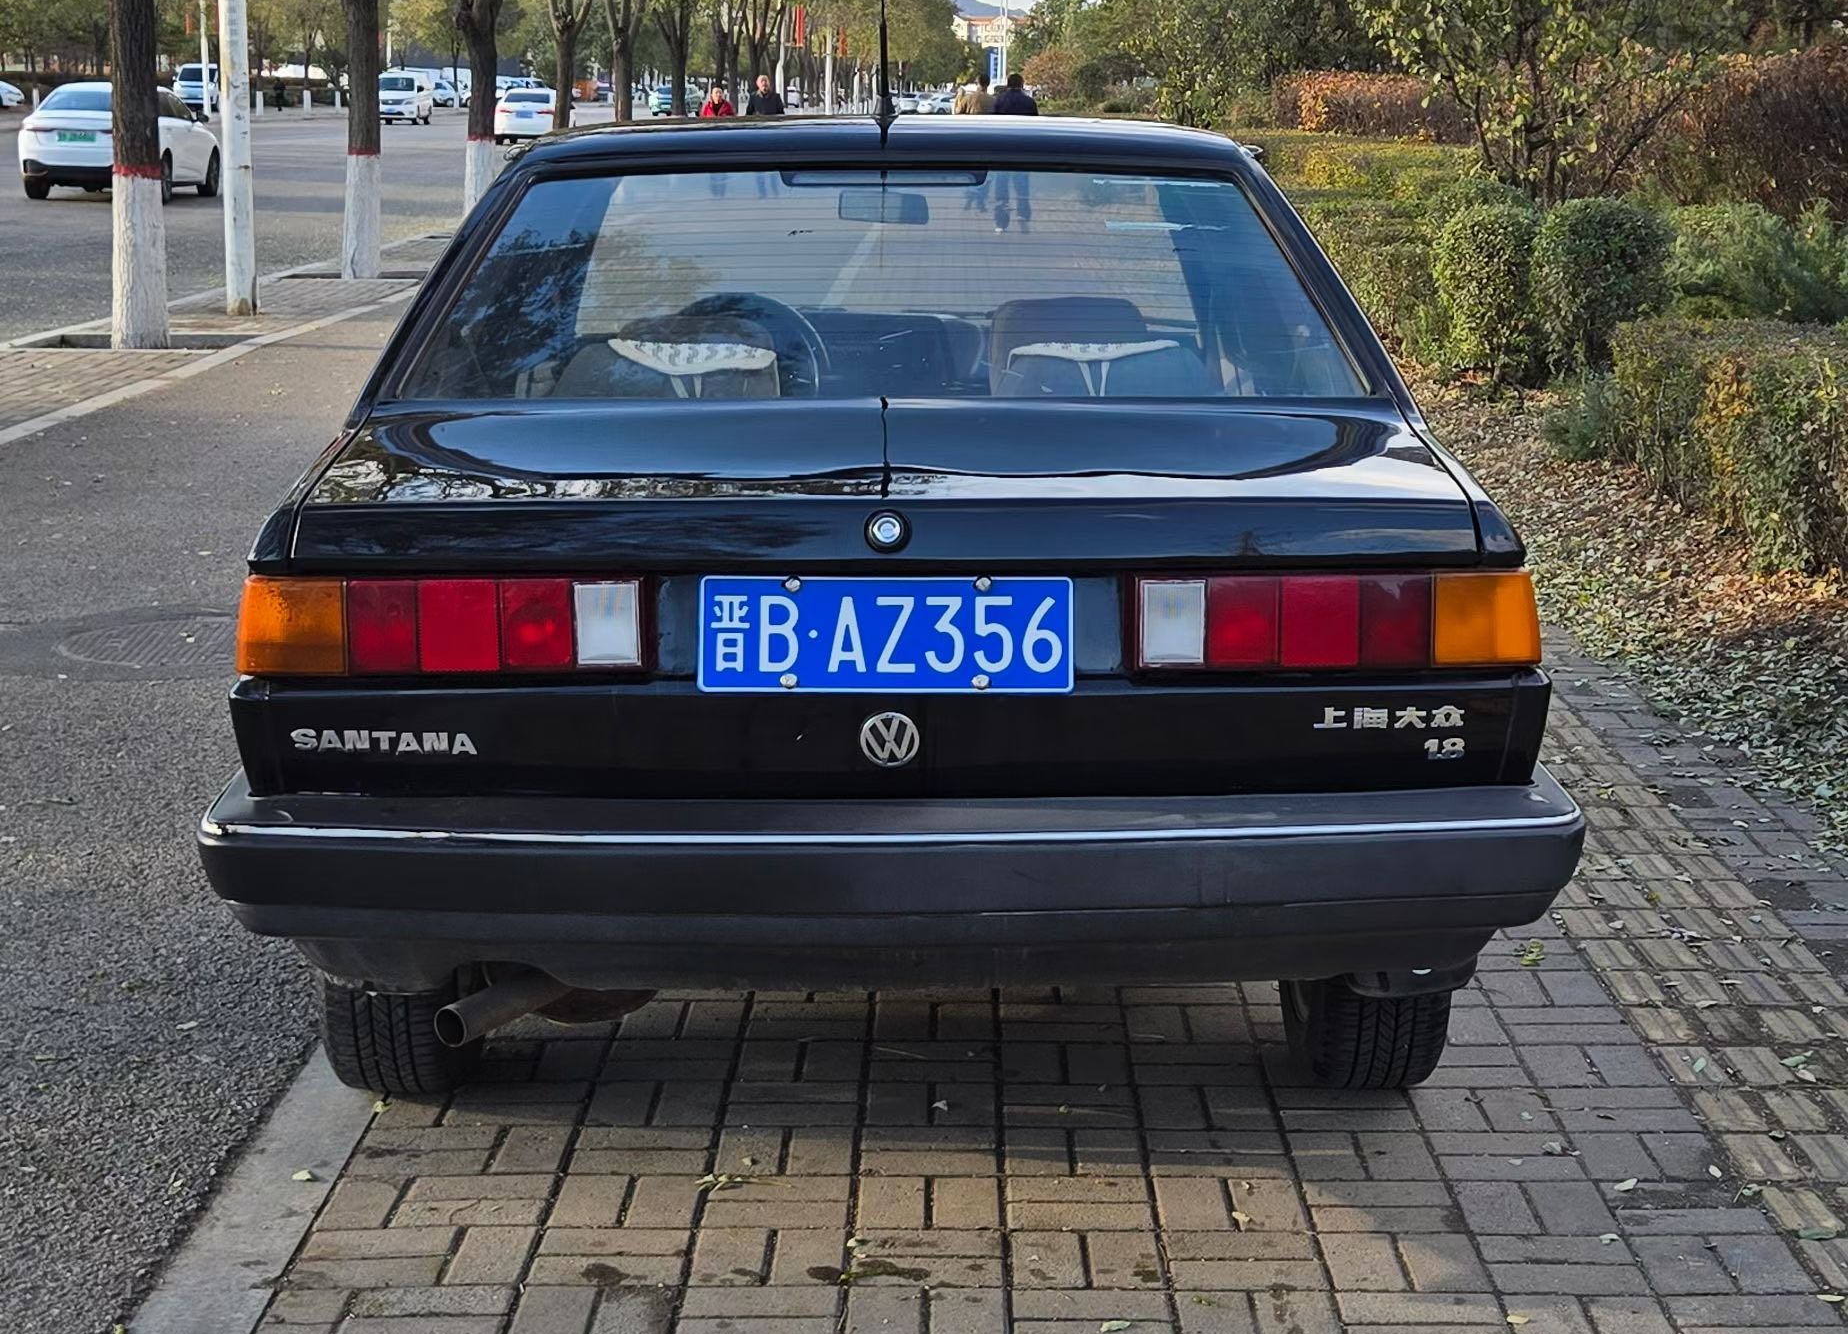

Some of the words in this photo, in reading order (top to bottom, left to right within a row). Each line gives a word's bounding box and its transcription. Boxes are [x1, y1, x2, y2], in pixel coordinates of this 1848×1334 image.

[1313, 705, 1465, 729] 上海大众
[290, 728, 478, 755] SANTANA
